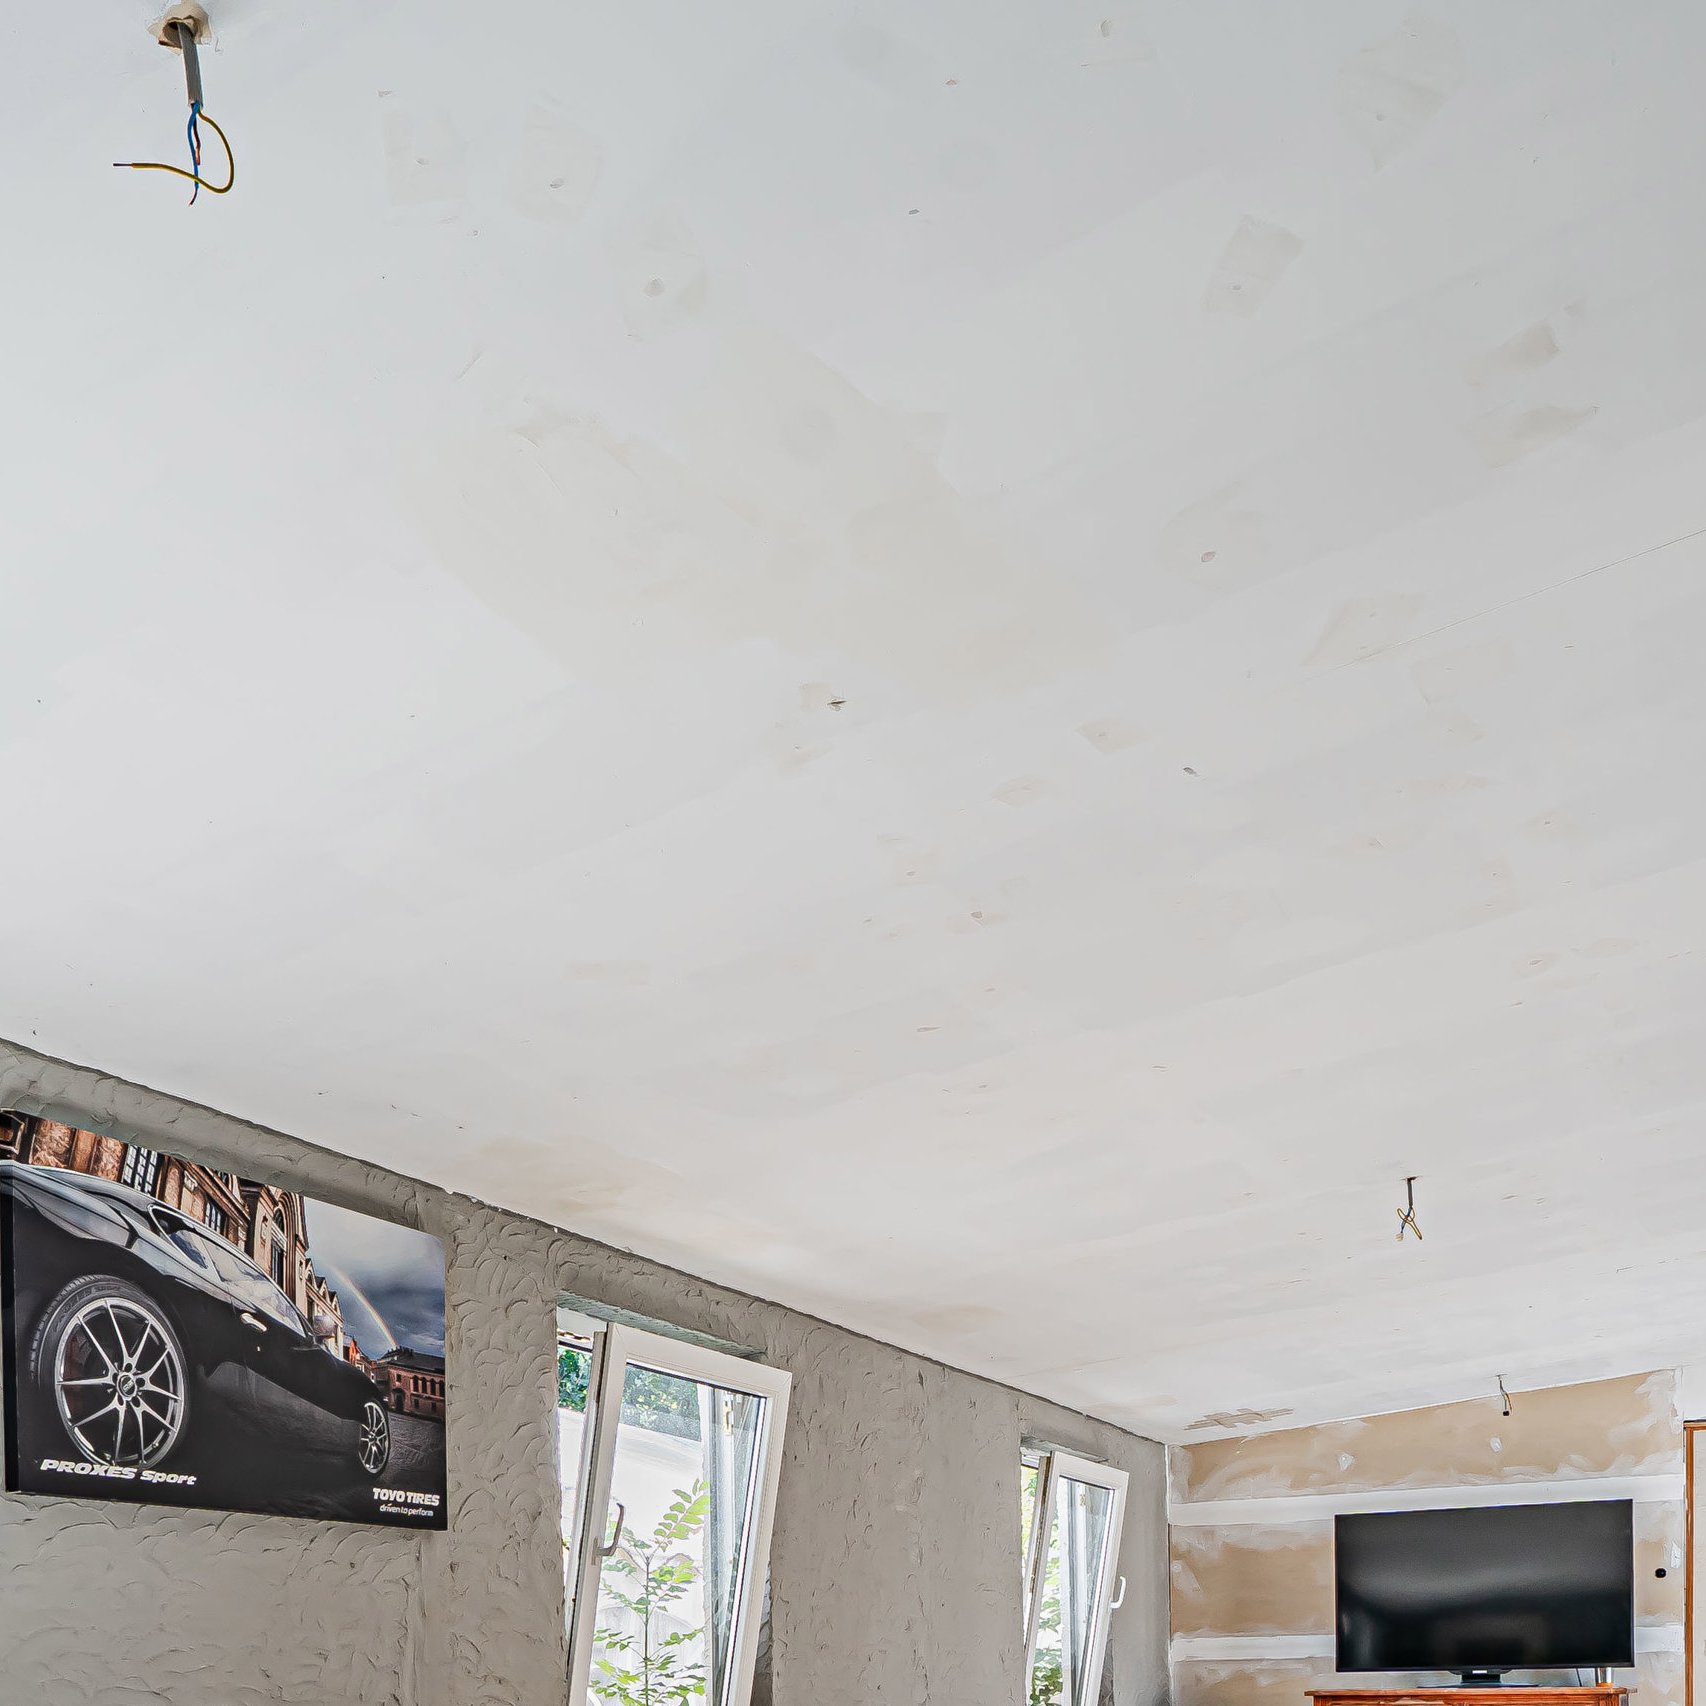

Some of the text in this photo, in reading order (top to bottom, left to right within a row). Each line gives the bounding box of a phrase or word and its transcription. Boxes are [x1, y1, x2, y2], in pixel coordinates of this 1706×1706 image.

[40, 1459, 197, 1485] PROXES Sport
[373, 1487, 440, 1506] TOYO TIRES
